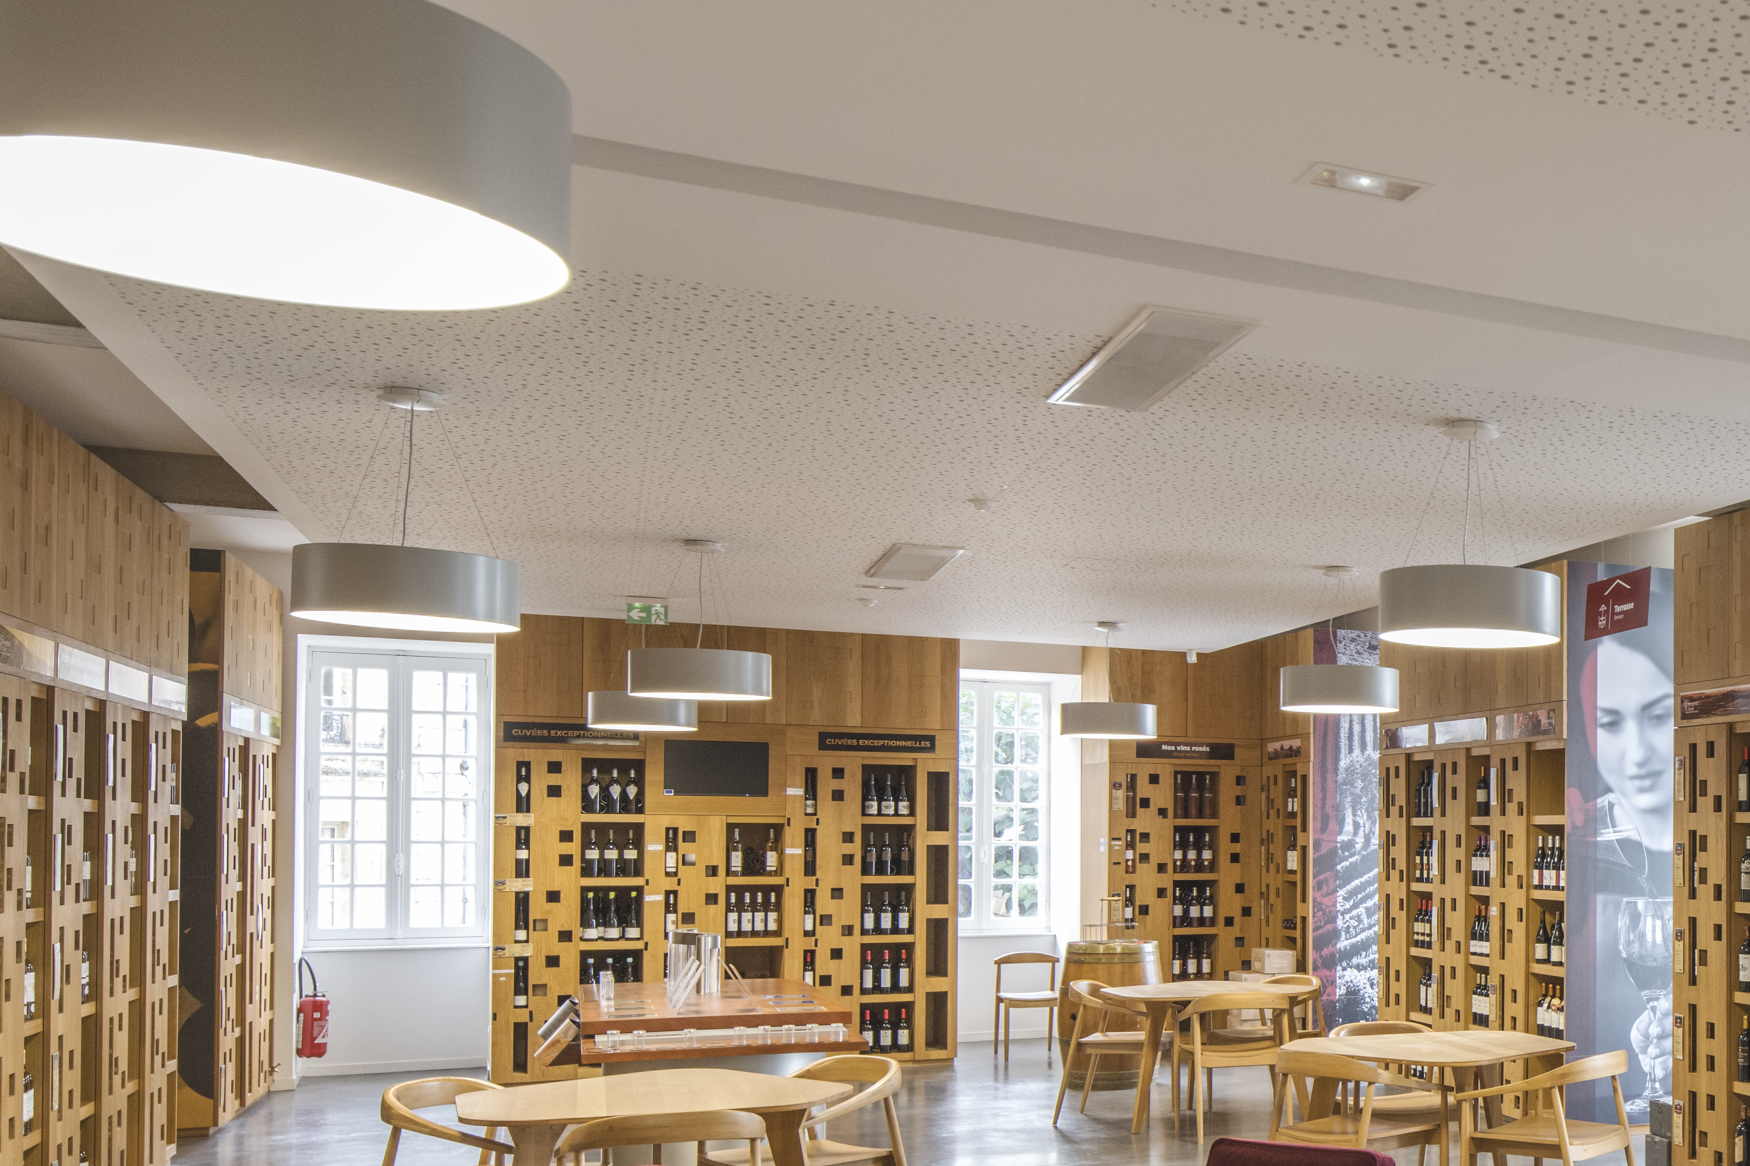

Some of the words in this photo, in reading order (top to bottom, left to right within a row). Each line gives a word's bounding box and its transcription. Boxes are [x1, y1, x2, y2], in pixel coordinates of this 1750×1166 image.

[1614, 602, 1635, 613] Terrasse
[512, 728, 549, 737] CUVÉES
[550, 730, 634, 739] EXCEPTIONNELLES
[826, 738, 858, 746] CUVÉES
[859, 739, 931, 748] EXCEPTIONNELLES
